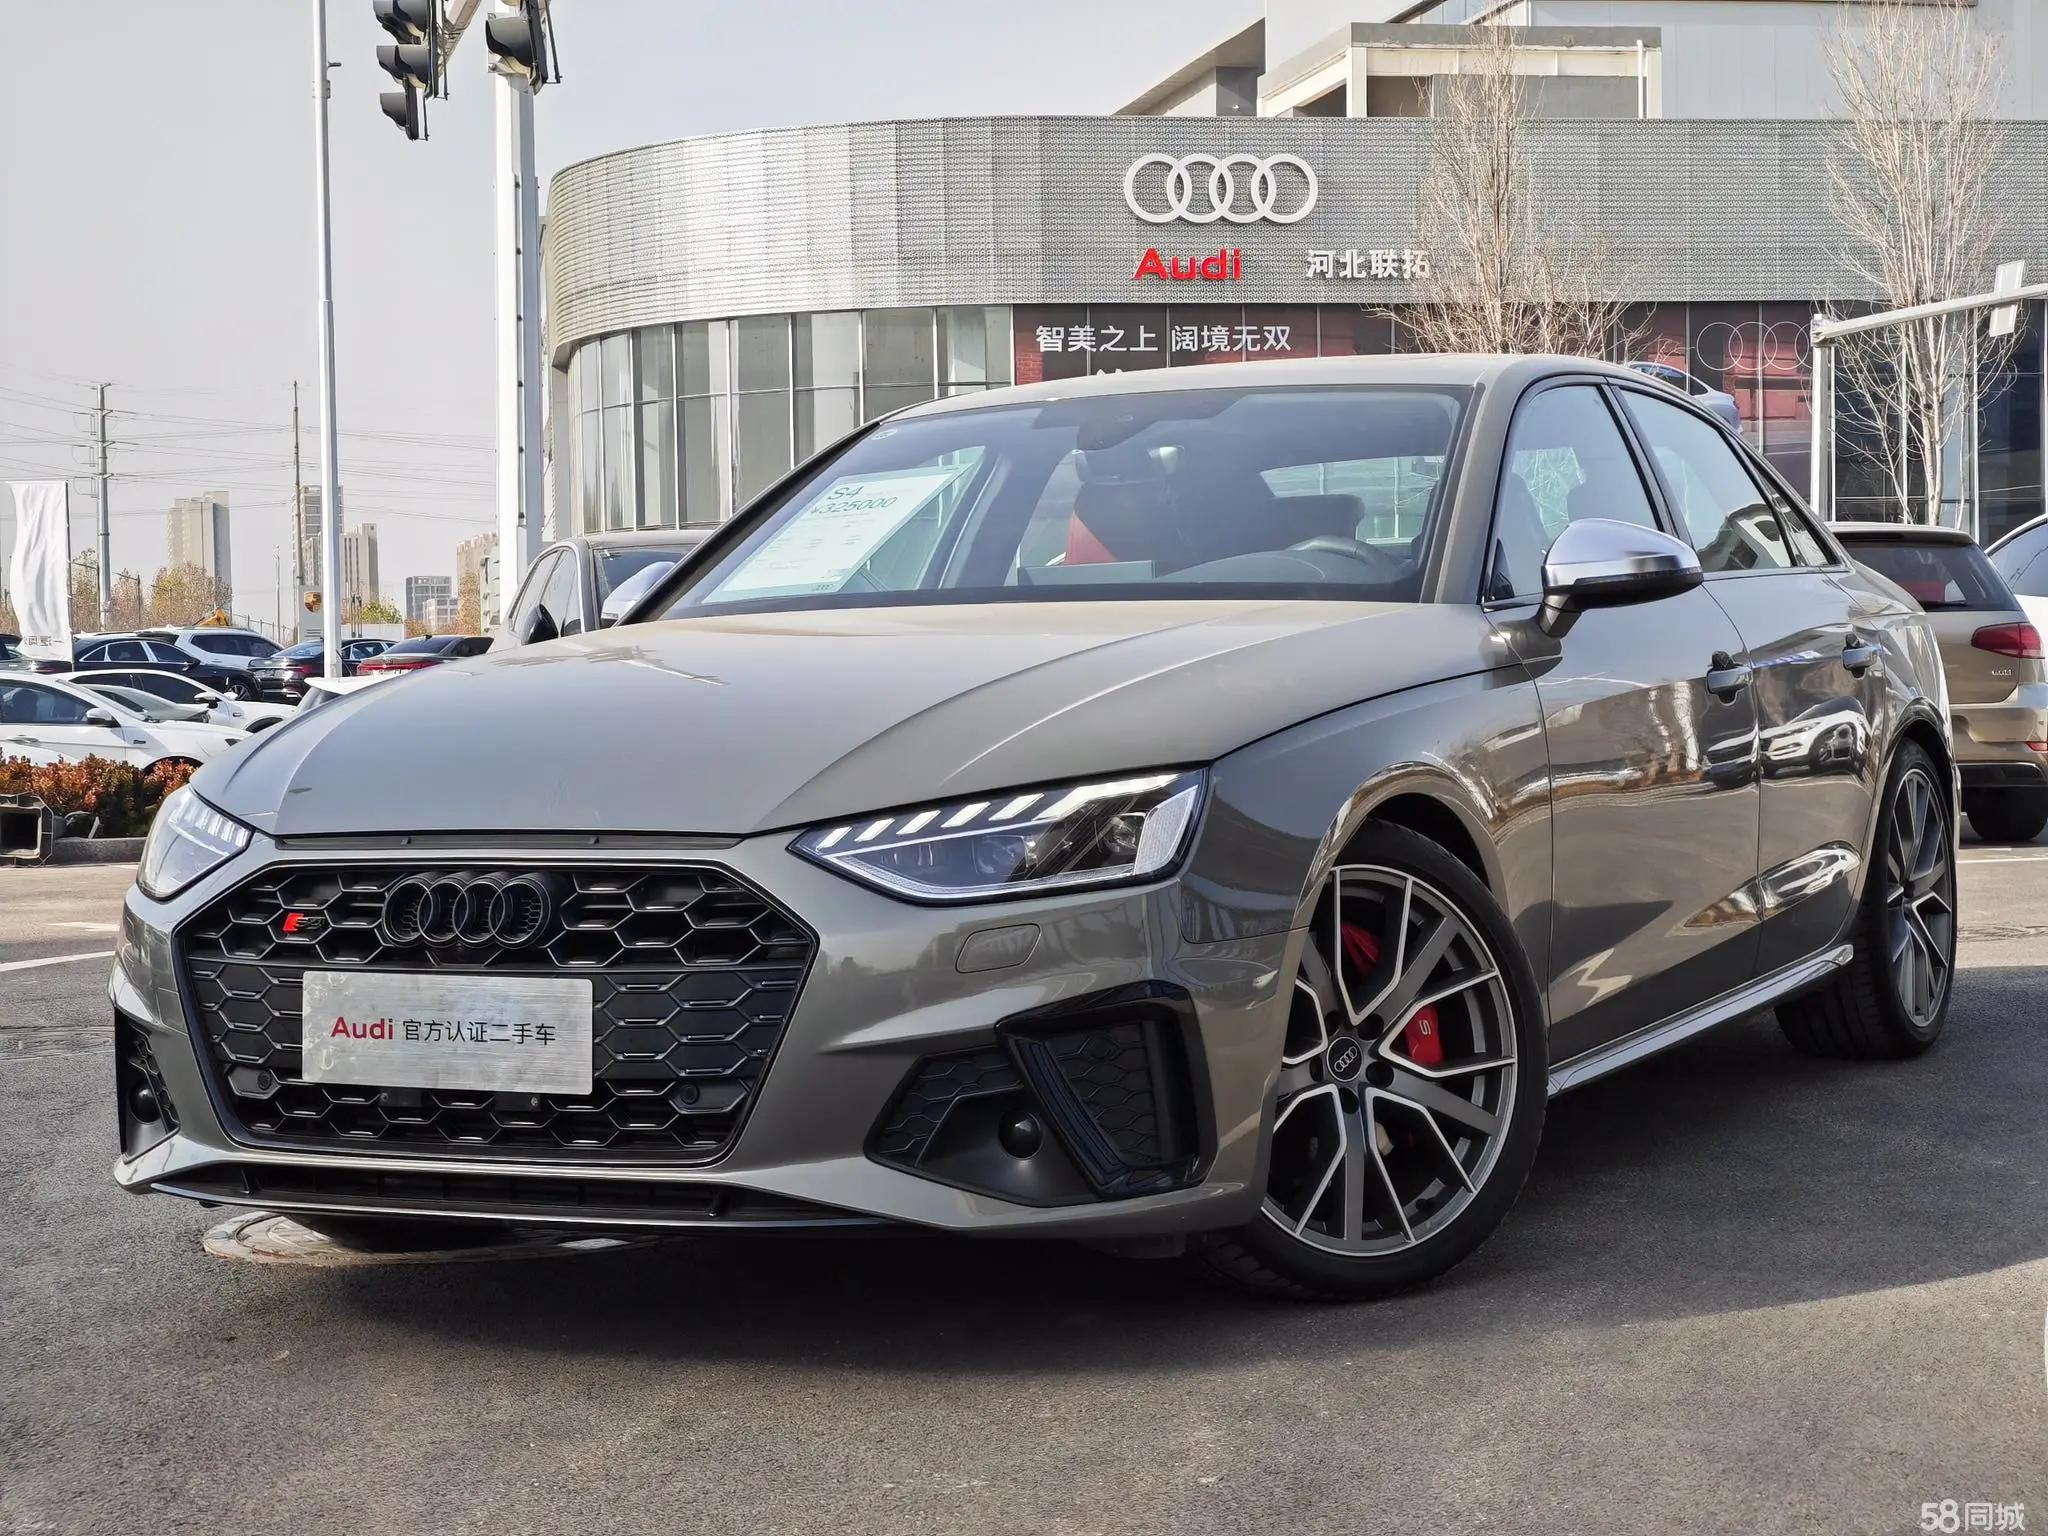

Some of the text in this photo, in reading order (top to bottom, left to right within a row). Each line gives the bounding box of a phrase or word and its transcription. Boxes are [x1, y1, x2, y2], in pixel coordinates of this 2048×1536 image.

[1133, 247, 1241, 281] Audi
[1306, 250, 1431, 279] 河北联拓
[1035, 326, 1291, 353] 智美之上 阔境无双
[827, 486, 864, 500] S4
[330, 1016, 556, 1046] Audi 官方认证二手车
